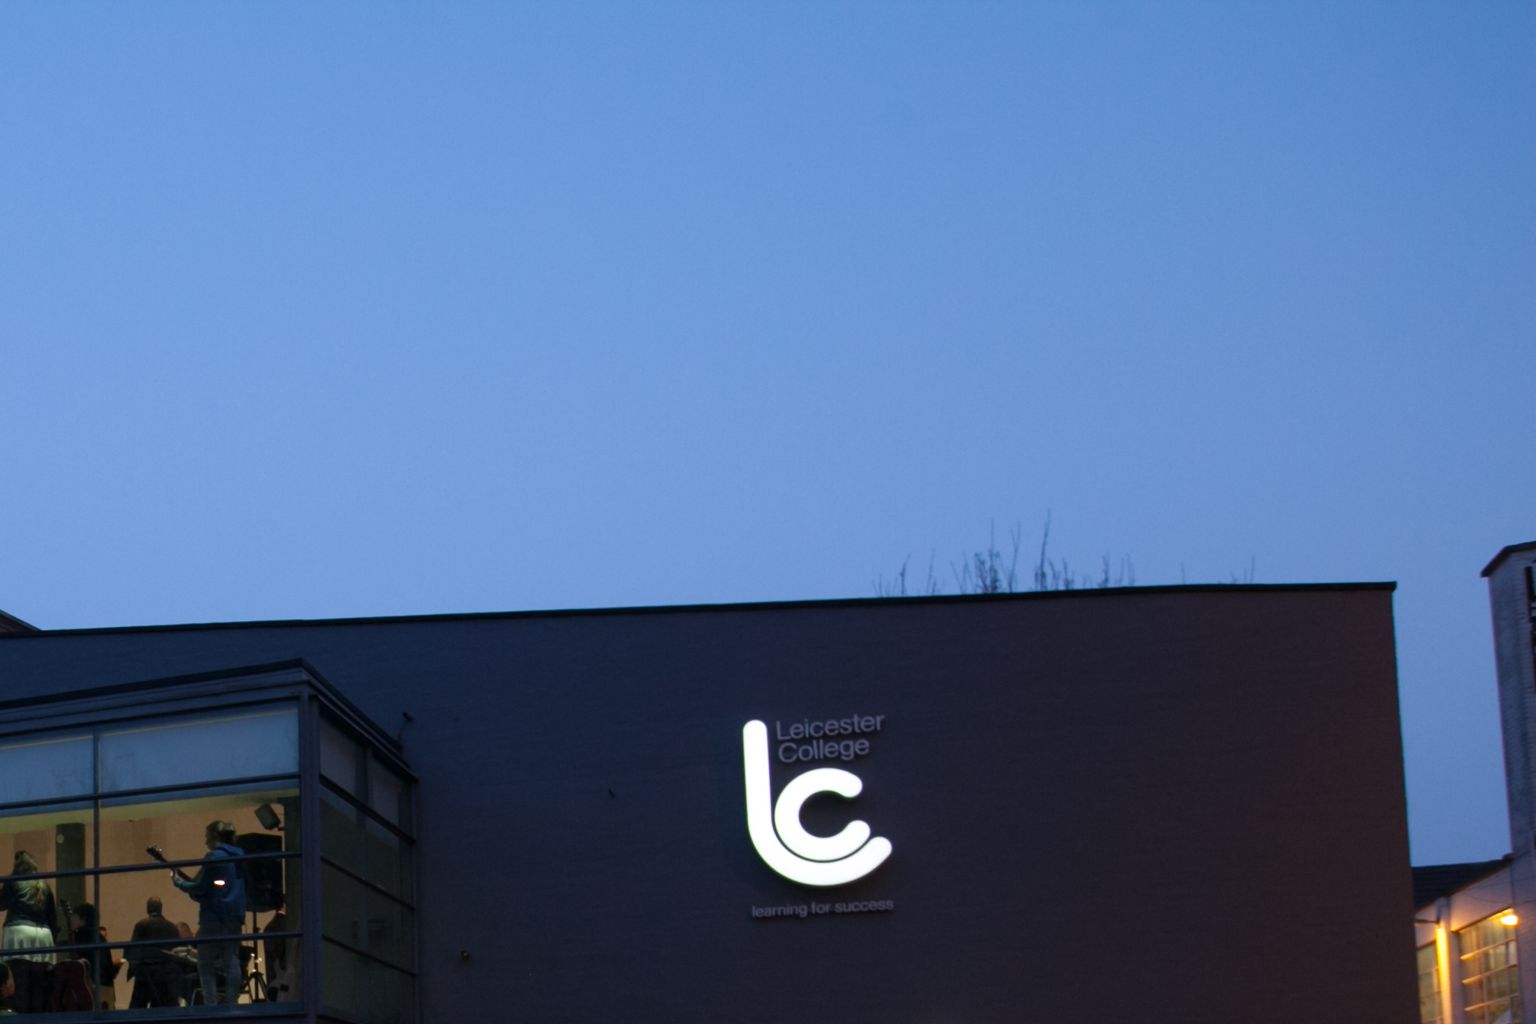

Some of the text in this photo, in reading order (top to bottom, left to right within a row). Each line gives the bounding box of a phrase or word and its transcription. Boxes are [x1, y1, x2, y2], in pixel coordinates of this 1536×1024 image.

[776, 714, 885, 741] Leicester
[778, 738, 870, 763] College
[751, 900, 894, 918] learning for success
